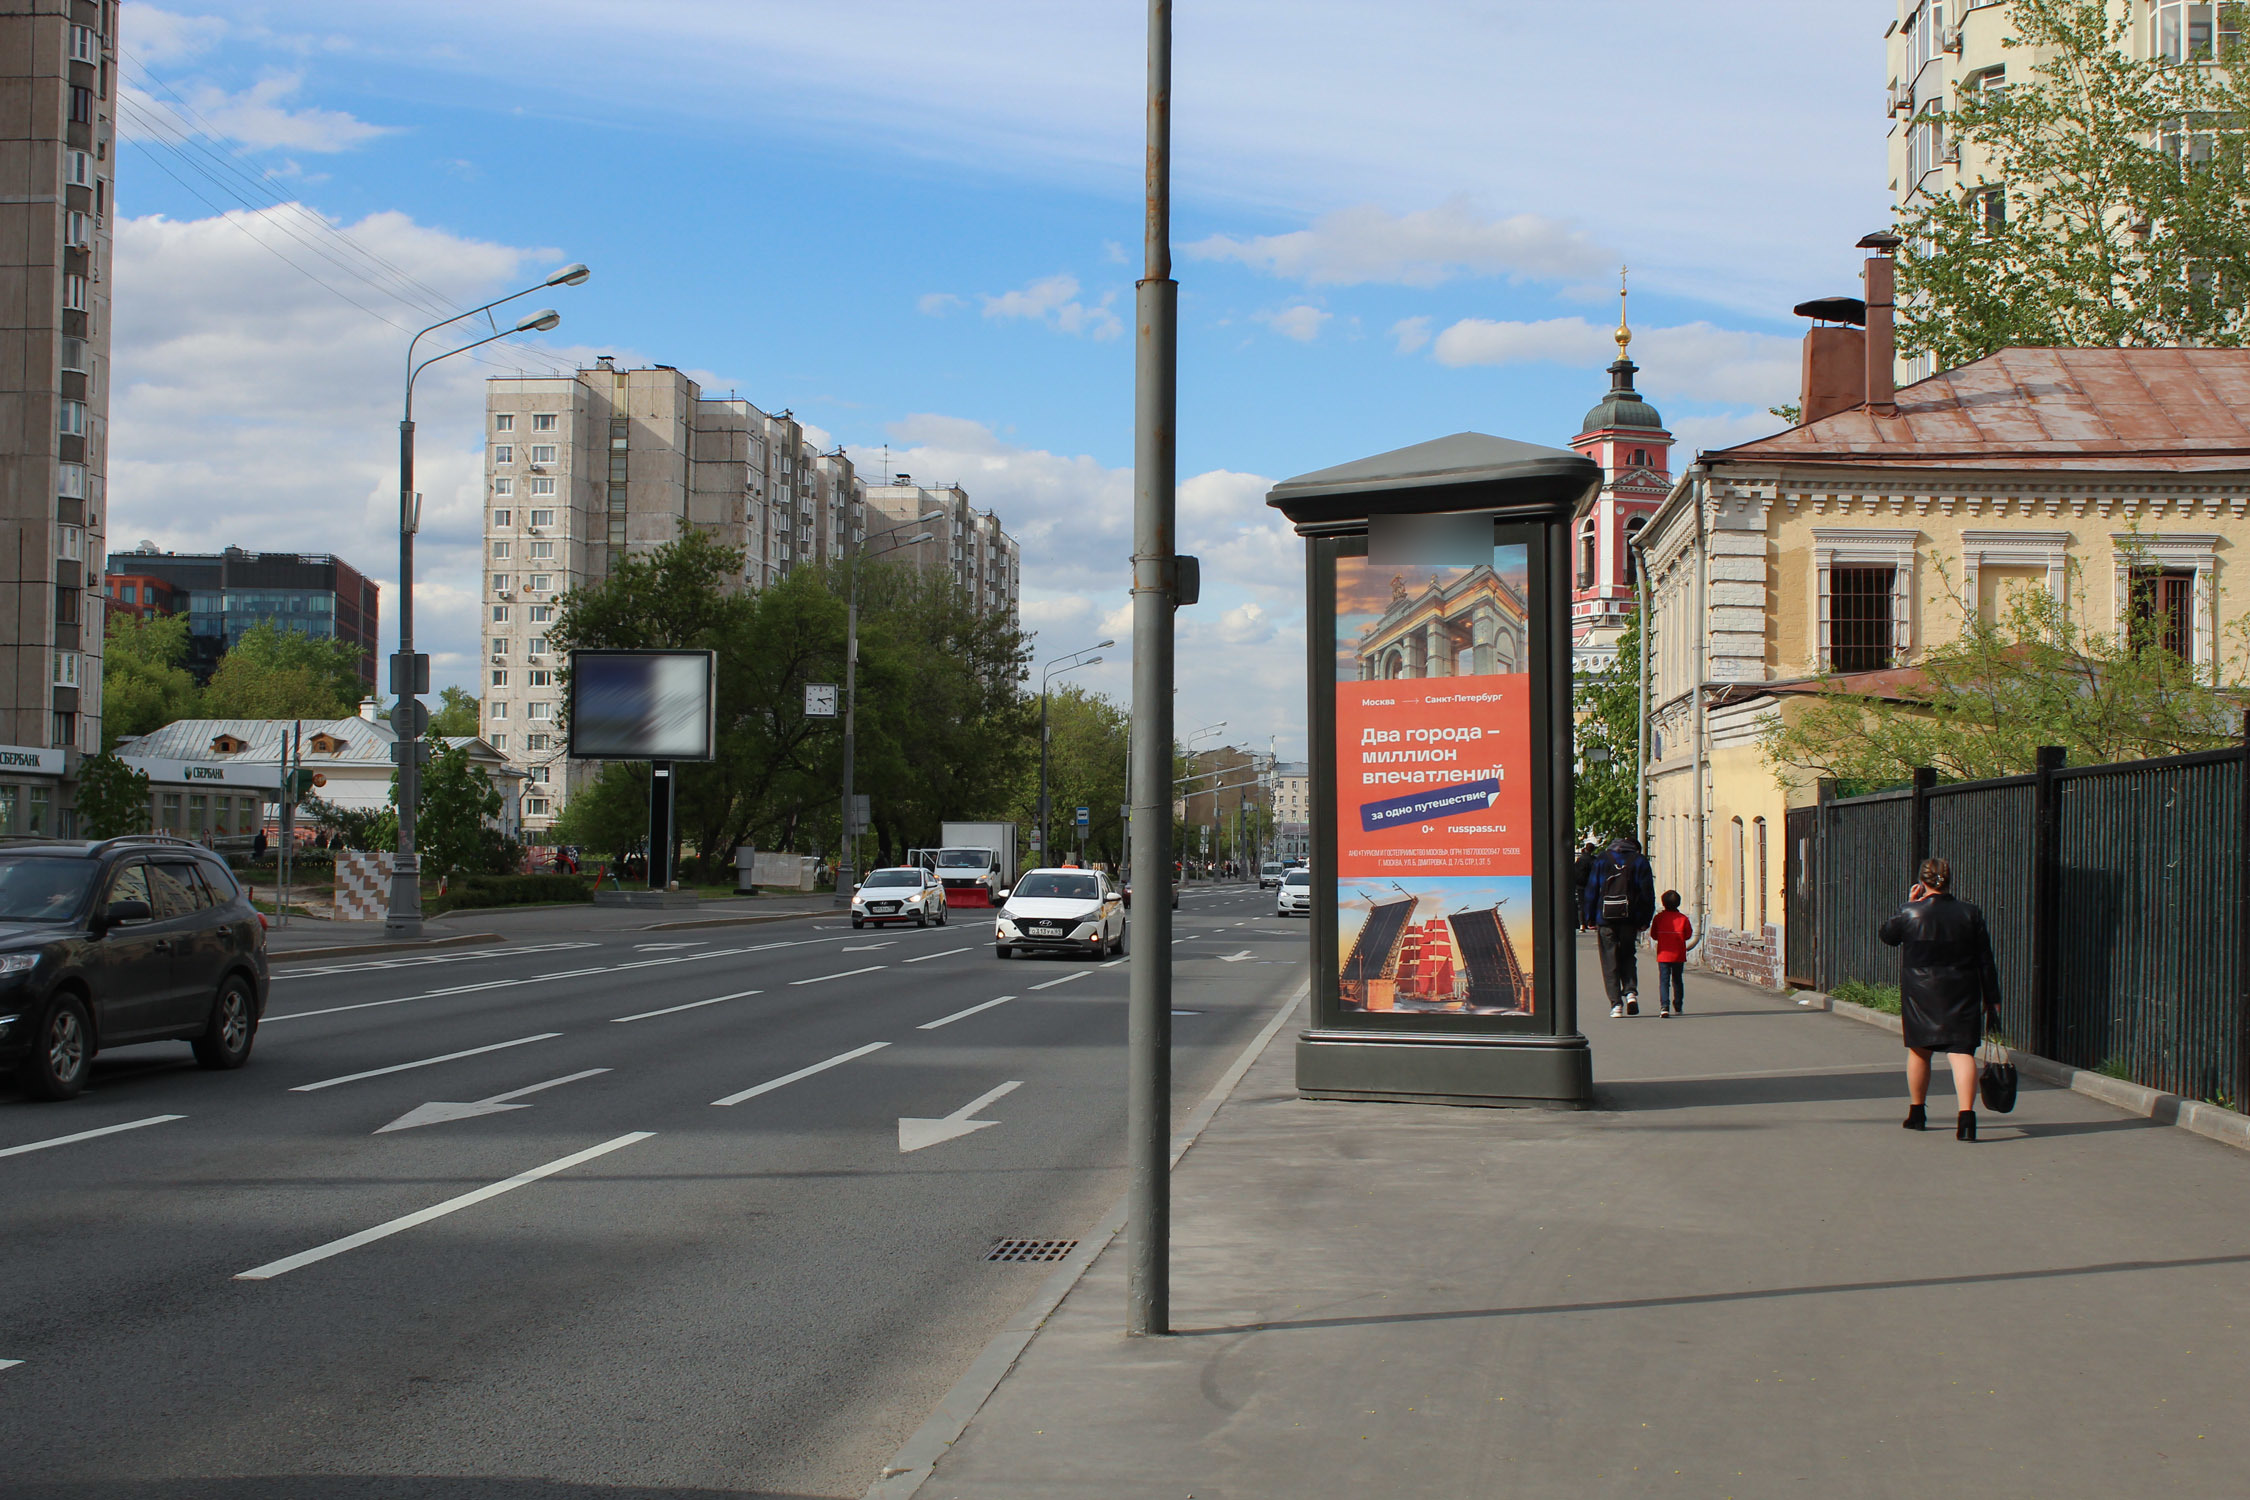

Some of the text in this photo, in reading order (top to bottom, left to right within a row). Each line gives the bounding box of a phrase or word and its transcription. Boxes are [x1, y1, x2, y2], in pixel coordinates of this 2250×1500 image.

[1362, 693, 1503, 706] Москва Санкт-Петербург
[1361, 728, 1400, 746] Два
[1406, 726, 1482, 744] города
[0, 752, 40, 766] СБЕРБАНК
[1362, 749, 1457, 764] миллион
[193, 767, 225, 779] СБЕРБАНК
[1362, 764, 1504, 784] впечатлений
[1371, 791, 1487, 820] за одно путешествие
[1421, 825, 1507, 834] 0+ russpass.ru
